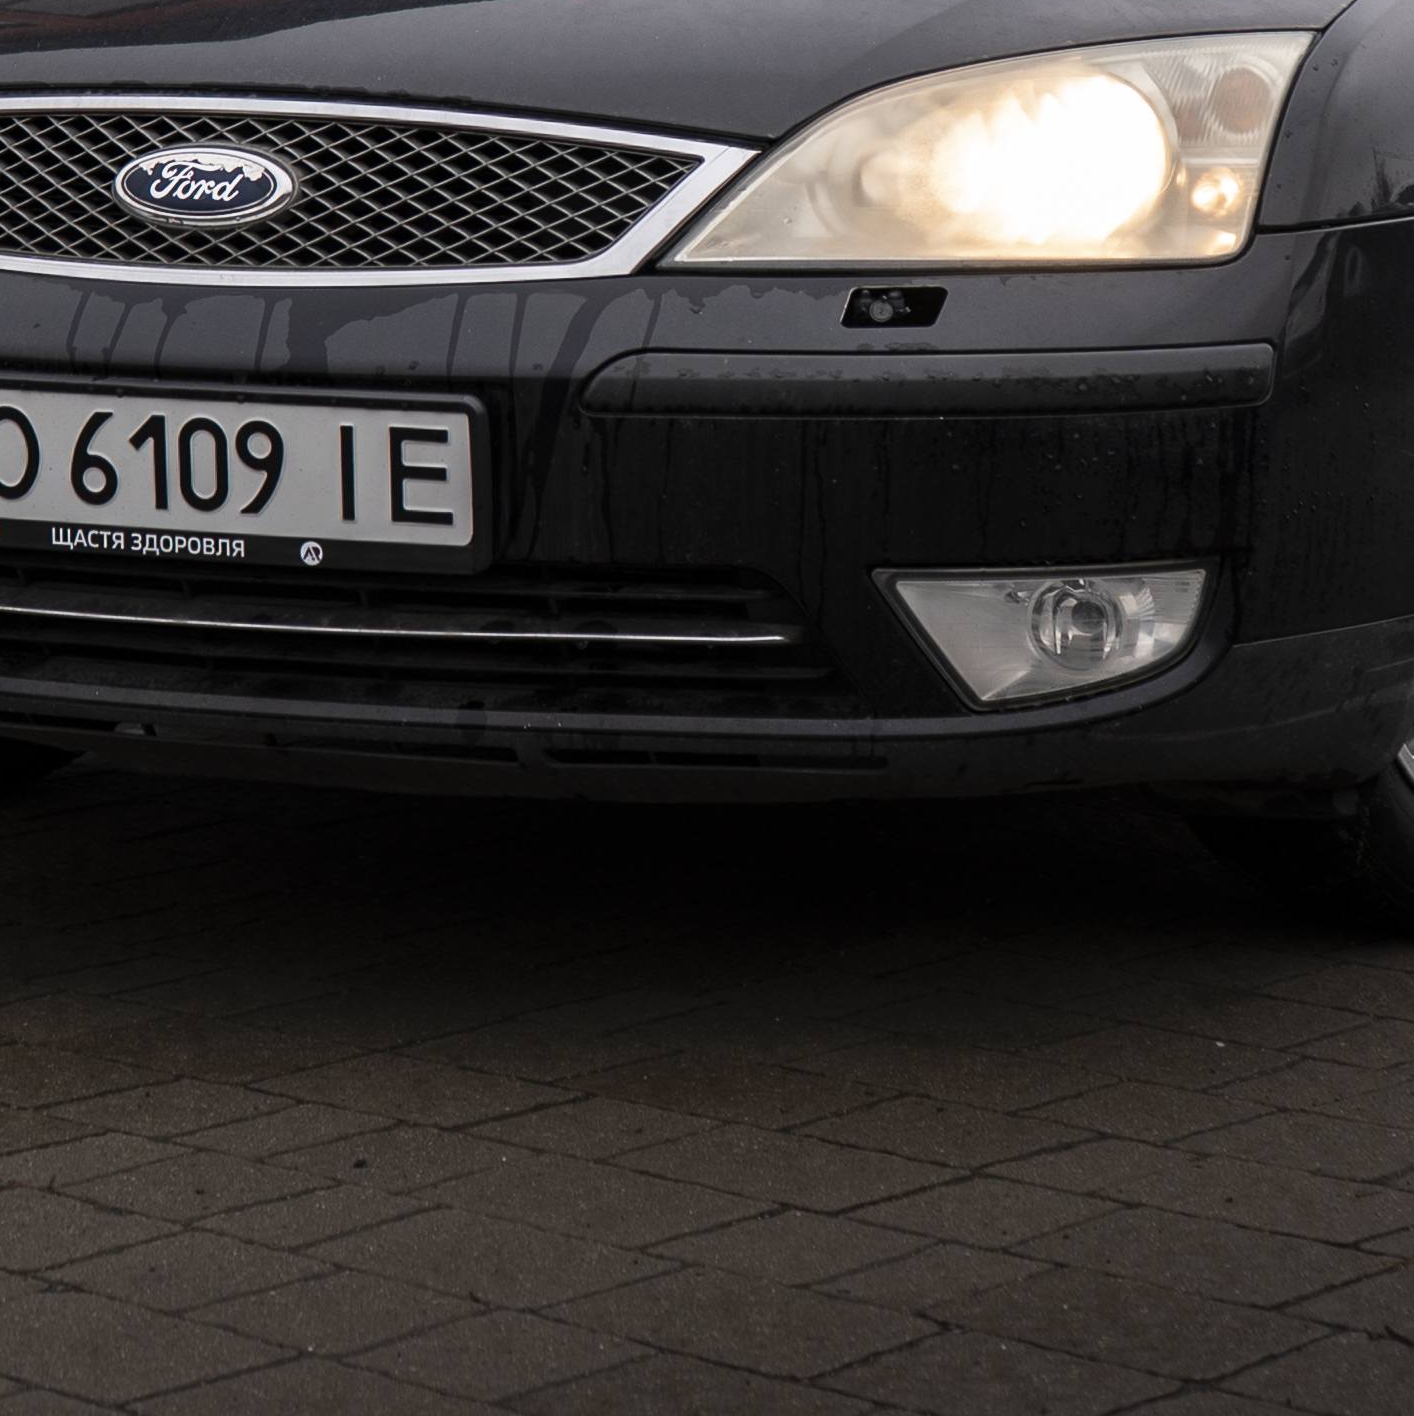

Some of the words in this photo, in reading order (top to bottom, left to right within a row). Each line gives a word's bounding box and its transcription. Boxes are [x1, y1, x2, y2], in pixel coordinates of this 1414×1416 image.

[149, 160, 244, 202] Ford
[69, 410, 286, 515] 6109
[339, 423, 455, 526] IE
[51, 526, 125, 551] ЩАСТЯ
[130, 532, 246, 559] ЗДОРОВЛЯ
